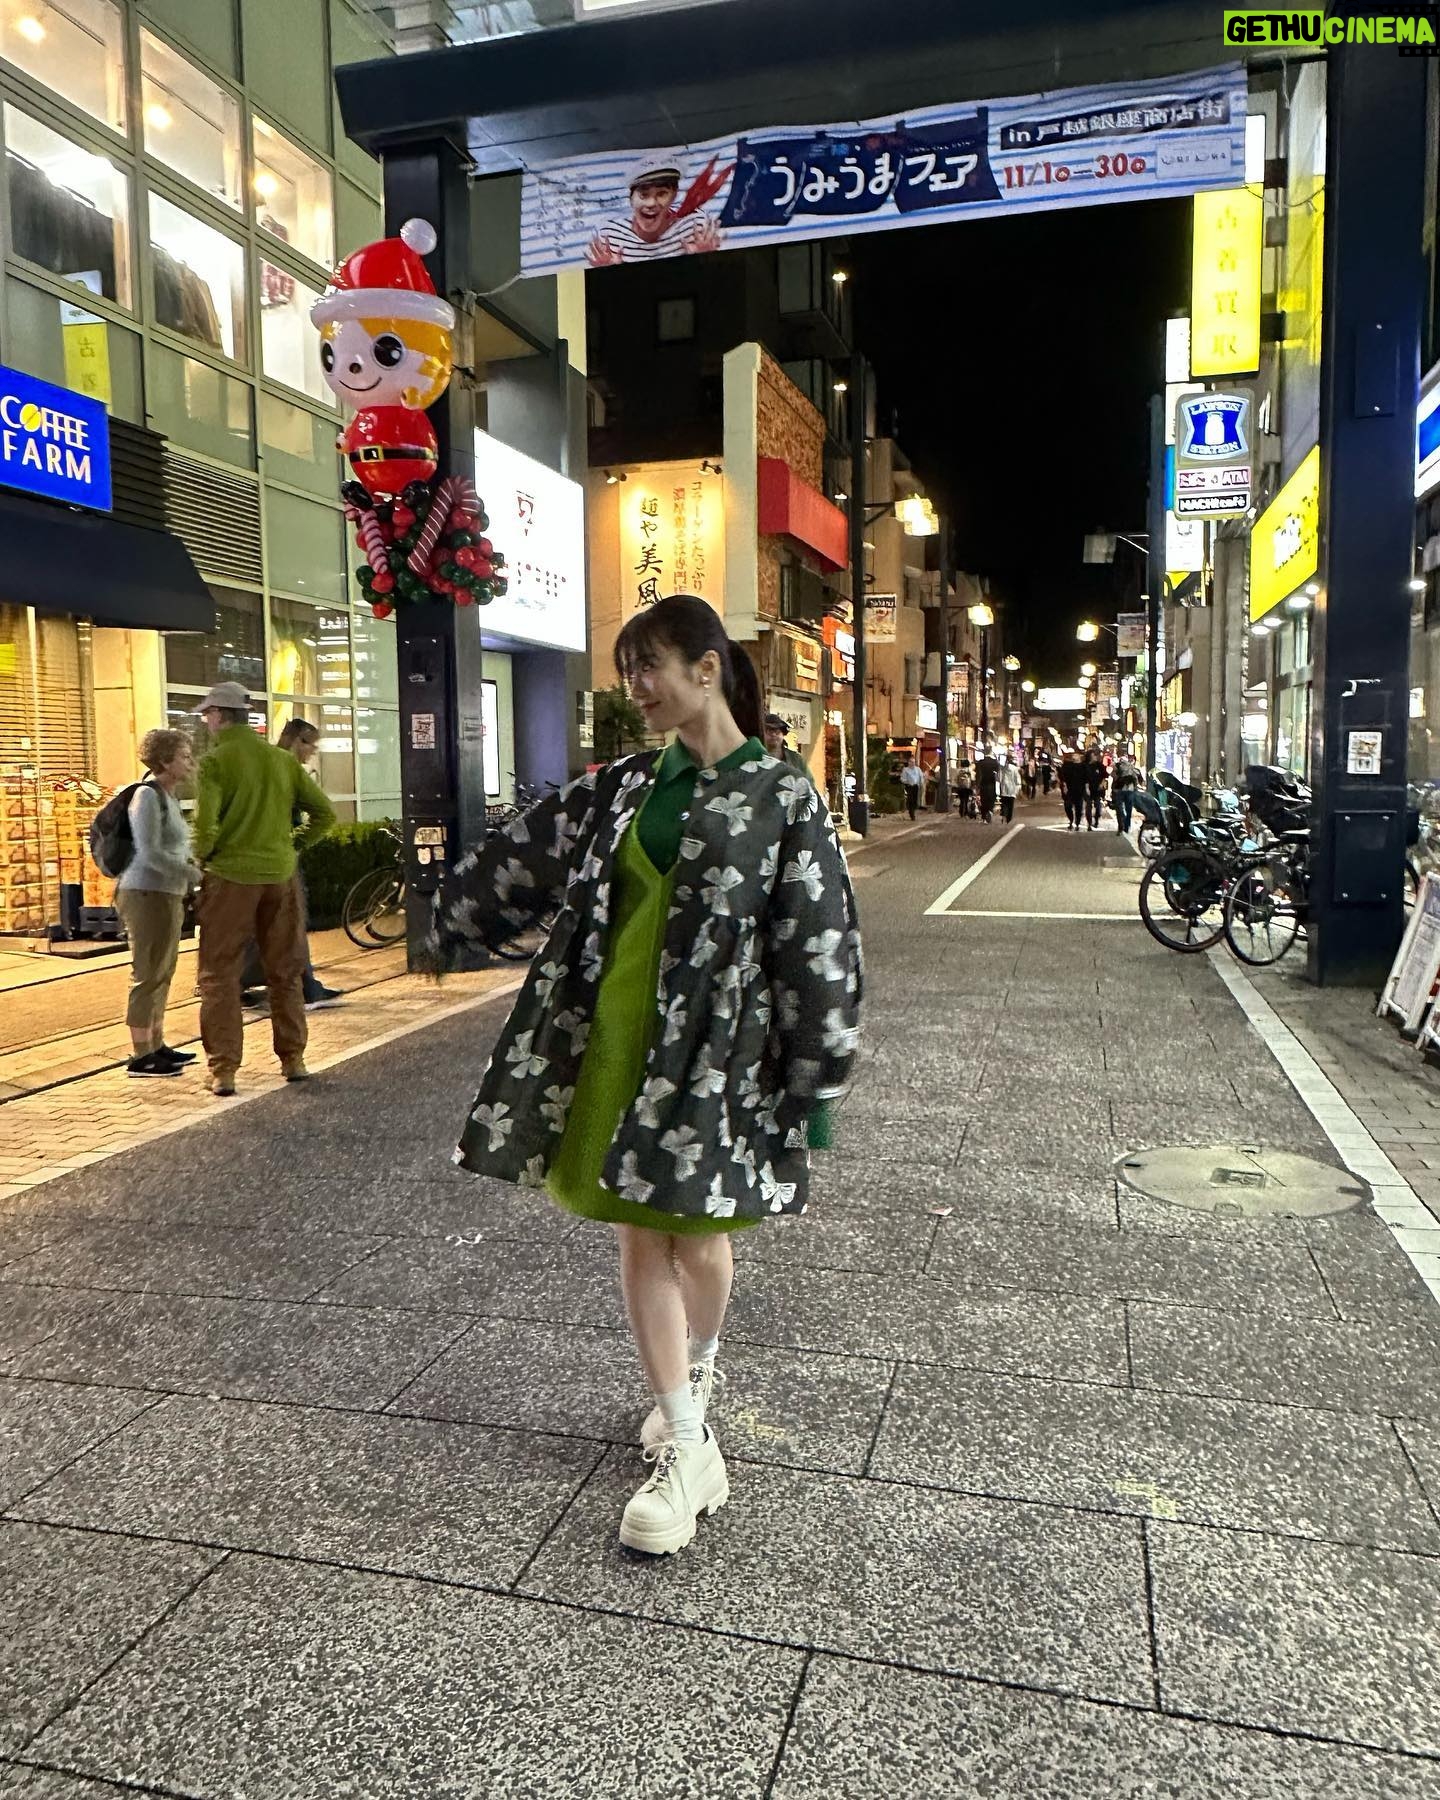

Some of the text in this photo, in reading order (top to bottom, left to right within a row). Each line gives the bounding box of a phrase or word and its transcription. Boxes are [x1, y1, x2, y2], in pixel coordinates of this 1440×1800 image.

[1009, 129, 1030, 142] in
[1, 395, 91, 451] COFFEE
[2, 430, 92, 484] FARM
